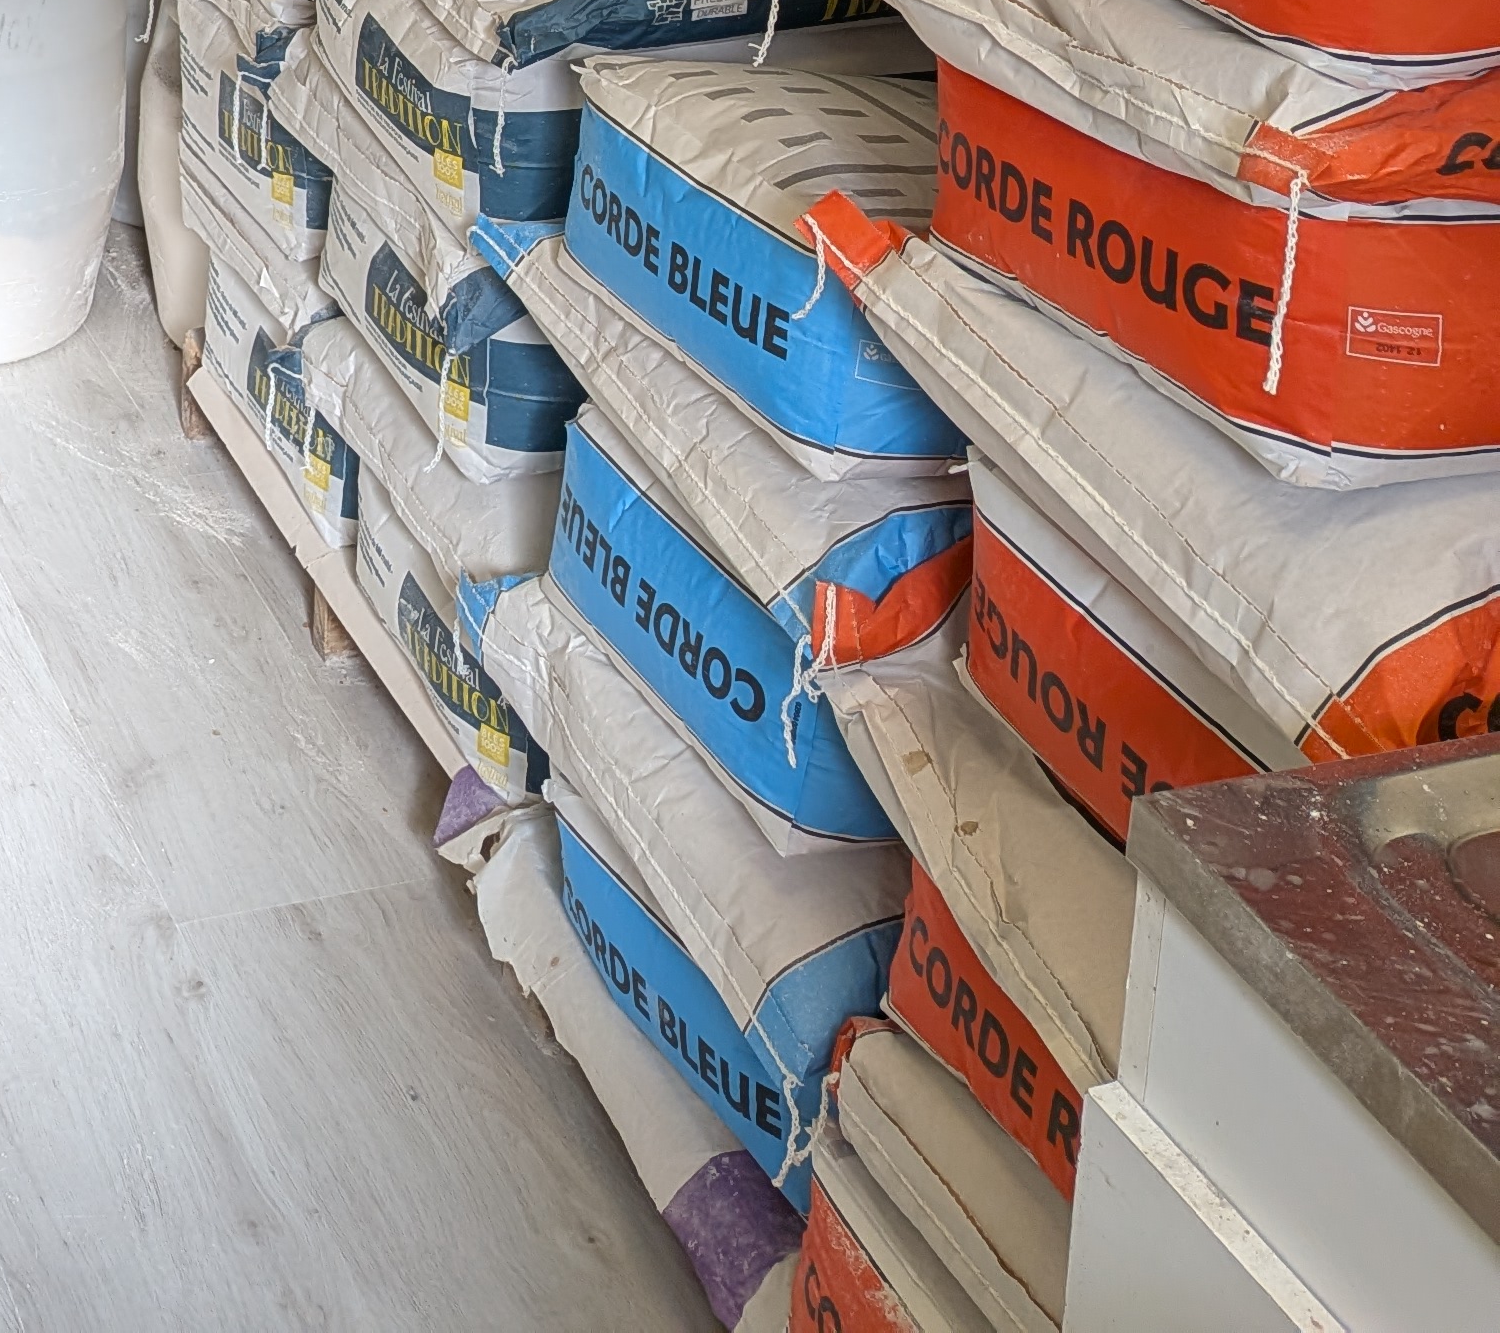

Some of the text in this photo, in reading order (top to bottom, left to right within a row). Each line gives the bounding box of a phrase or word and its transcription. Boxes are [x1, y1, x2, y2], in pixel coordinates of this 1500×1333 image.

[362, 56, 464, 156] TRADITION
[377, 41, 433, 114] La Festival
[696, 2, 744, 18] DURABLE
[385, 269, 400, 304] La
[578, 163, 796, 361] CORDE BLEUE
[935, 120, 1280, 347] CORDE ROUGE
[1378, 323, 1434, 338] Gascogne
[560, 482, 768, 724] CORDE BLEUE
[973, 577, 1107, 773] ROUGE
[562, 872, 785, 1142] CORDE BLEUE
[908, 915, 1039, 1118] CORDE
